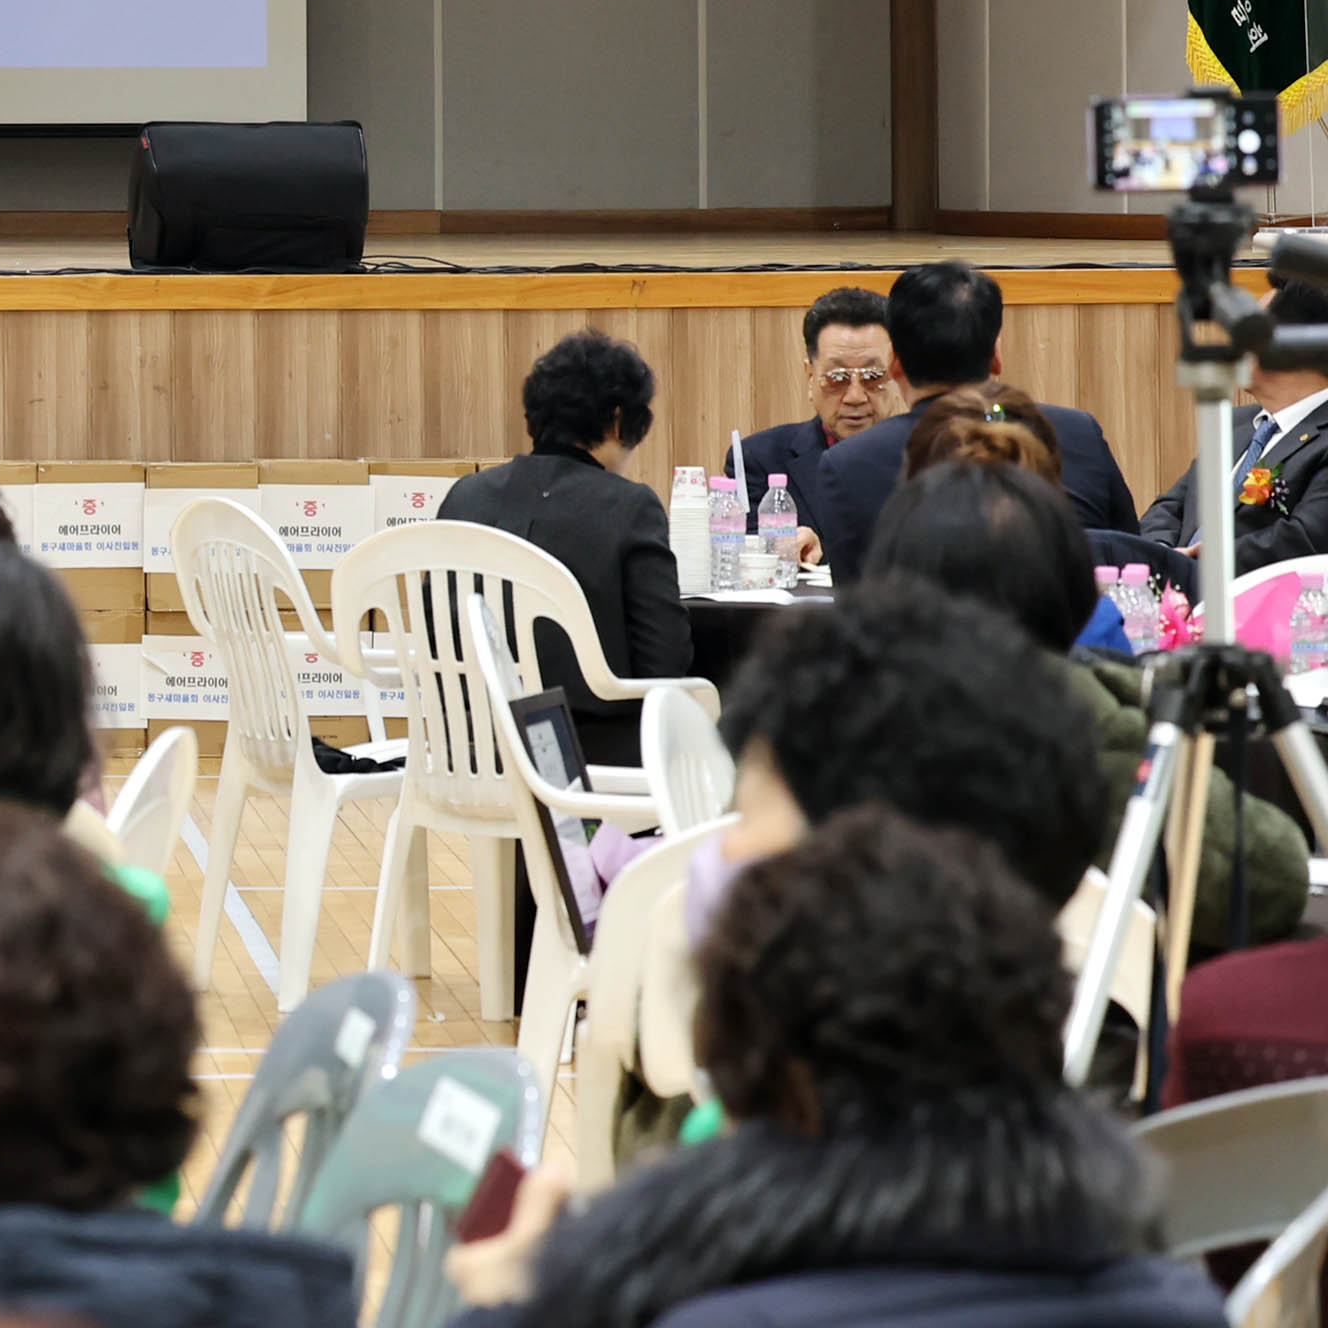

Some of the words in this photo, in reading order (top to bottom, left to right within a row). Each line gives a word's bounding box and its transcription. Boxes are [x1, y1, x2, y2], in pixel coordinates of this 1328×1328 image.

[58, 524, 121, 536] 에어프라이어
[279, 526, 342, 537] 에어프라이어
[41, 541, 92, 552] 동구새마을회
[166, 676, 228, 688] 에어프라이어
[148, 693, 199, 703] 동구새마을회
